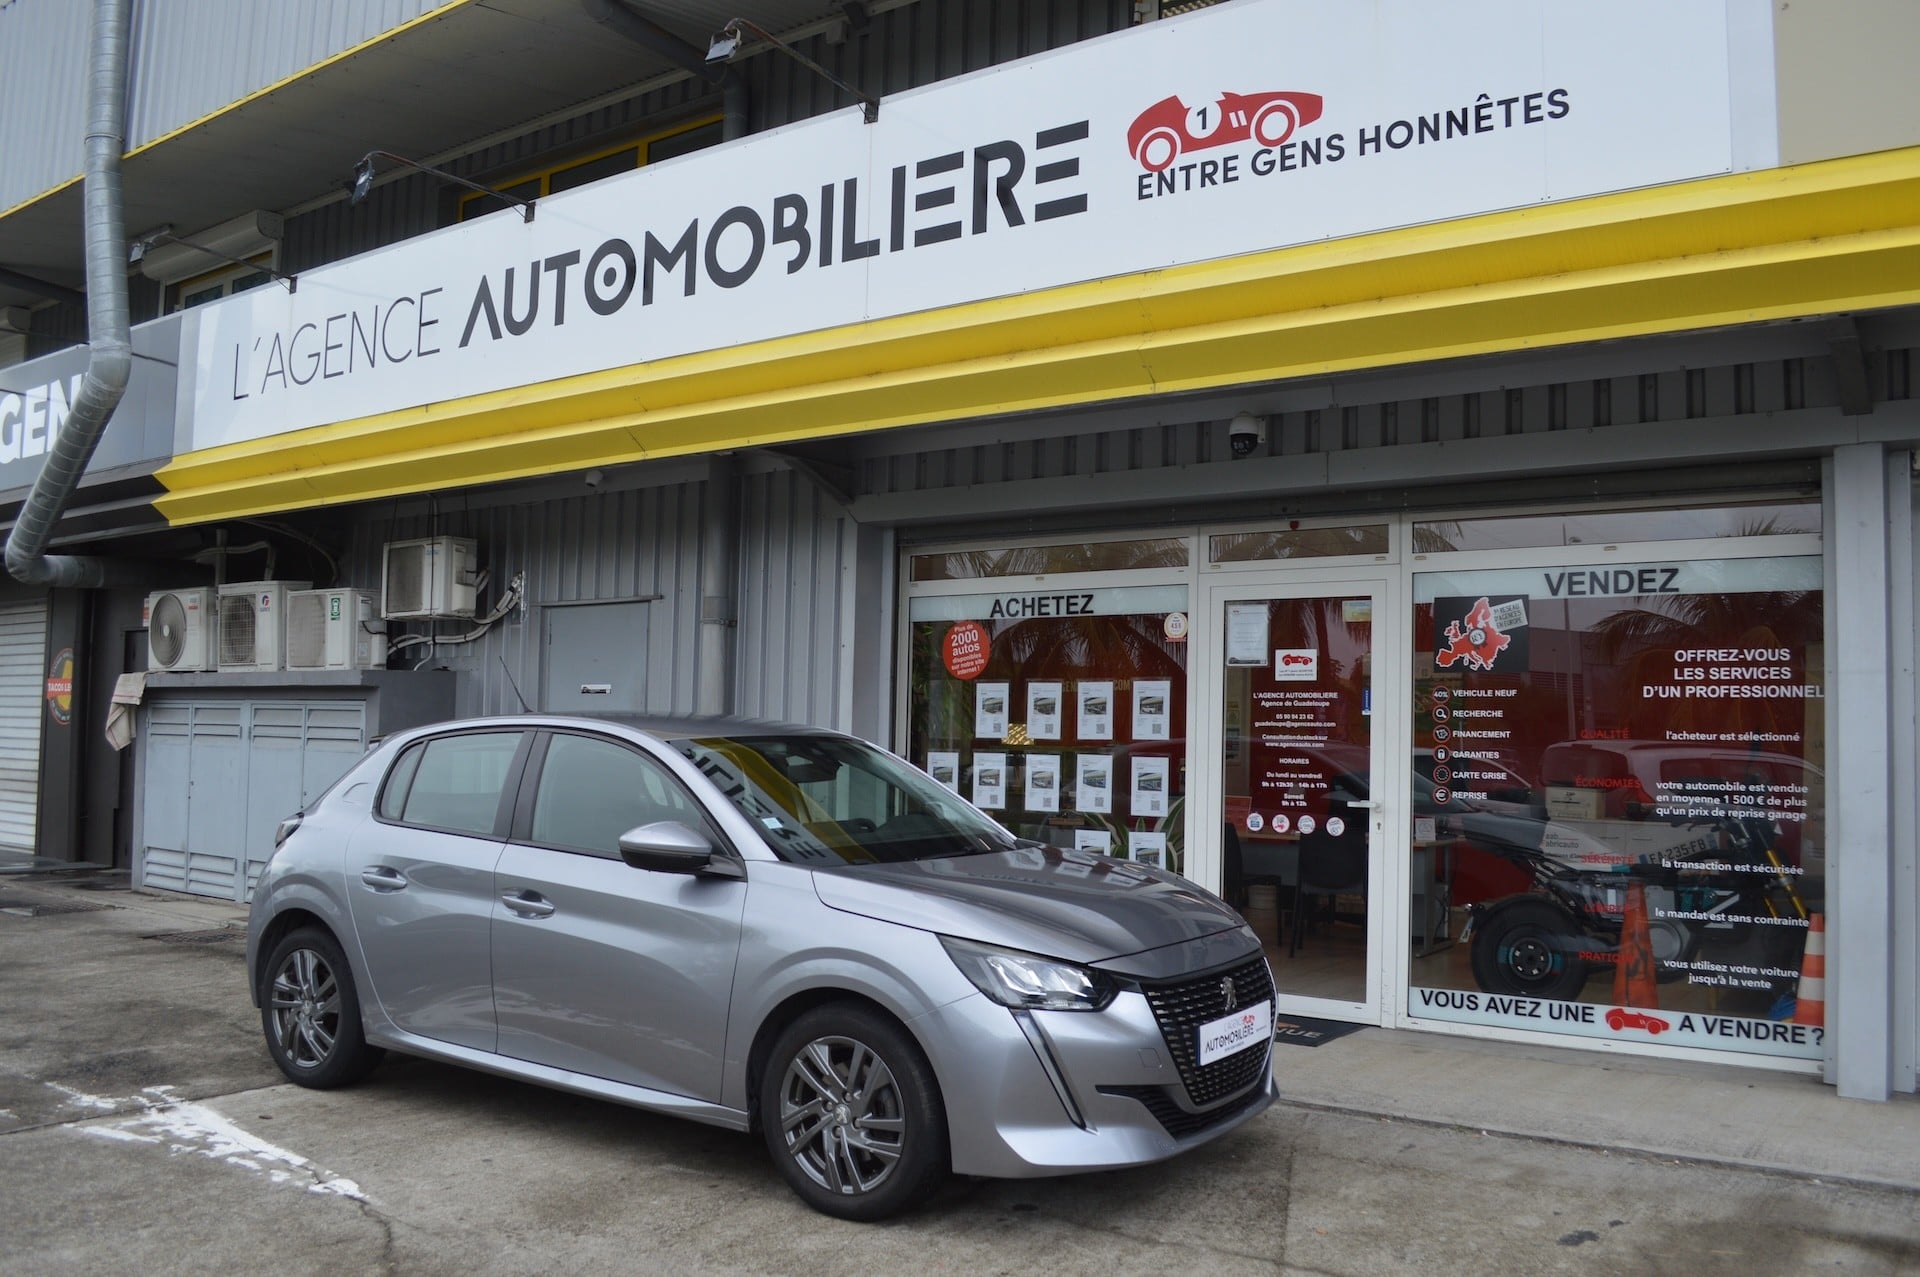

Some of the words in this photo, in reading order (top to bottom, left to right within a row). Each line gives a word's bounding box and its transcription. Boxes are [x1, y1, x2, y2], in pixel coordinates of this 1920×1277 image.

[1138, 154, 1239, 200] ENTRE
[1250, 133, 1346, 177] GENS
[1359, 88, 1571, 156] HONNÊTES
[233, 287, 444, 400] L'AGENCE
[458, 119, 1090, 349] AUTOMOBILIERE
[1544, 568, 1680, 596] VENDEZ
[989, 594, 1094, 618] ACHETEZ
[951, 630, 979, 647] 2000
[952, 642, 981, 656] autos
[1674, 648, 1791, 662] OFFREZ-VOUS
[1674, 668, 1705, 680] LES
[1709, 667, 1792, 680] SERVICES
[1642, 686, 1681, 698] D'UN
[1685, 685, 1825, 698] PROFESSIONNEL
[1452, 710, 1504, 718] RECHERCHE
[1452, 730, 1511, 738] FINANCEMENT
[1580, 728, 1630, 739] QUALITÉ
[1666, 730, 1717, 740] l'acheteur
[1720, 732, 1736, 740] est
[1738, 731, 1800, 742] sélectionné
[1452, 751, 1500, 759] GARANTIES
[1576, 776, 1641, 788] ÉCONOMIES
[1656, 782, 1683, 790] votre
[1685, 782, 1746, 792] automobile
[1748, 783, 1765, 792] est
[1767, 783, 1808, 794] vendue
[1452, 792, 1488, 800] REPRISE
[1672, 795, 1720, 806] moyenne
[1723, 795, 1729, 804] 1
[1732, 795, 1754, 805] 500
[1756, 796, 1765, 806] €
[1766, 796, 1782, 806] de
[1784, 797, 1808, 808] plus
[1656, 807, 1686, 817] qu'un
[1688, 808, 1710, 818] prix
[1712, 808, 1726, 817] de
[1728, 808, 1765, 820] reprise
[1768, 811, 1808, 822] garage
[1662, 858, 1671, 868] la
[1674, 860, 1732, 871] transaction
[1734, 862, 1750, 872] est
[1752, 862, 1804, 874] sécurisée
[1655, 907, 1664, 918] le
[1668, 908, 1708, 920] mandat
[1710, 912, 1726, 922] est
[1728, 914, 1752, 923] sans
[1754, 915, 1810, 928] contrainte
[1664, 960, 1688, 969] vous
[1690, 960, 1727, 972] utilisez
[1730, 964, 1758, 974] votre
[1760, 966, 1799, 978] voiture
[1688, 972, 1726, 986] jusqu'à
[1728, 976, 1738, 986] la
[1740, 978, 1772, 989] vente
[1420, 989, 1479, 1011] VOUS
[1485, 996, 1541, 1018] AVEZ
[1548, 1003, 1596, 1024] UNE
[1678, 1015, 1697, 1033] A
[1701, 1018, 1807, 1045] VENDRE
[1811, 1028, 1825, 1046] ?
